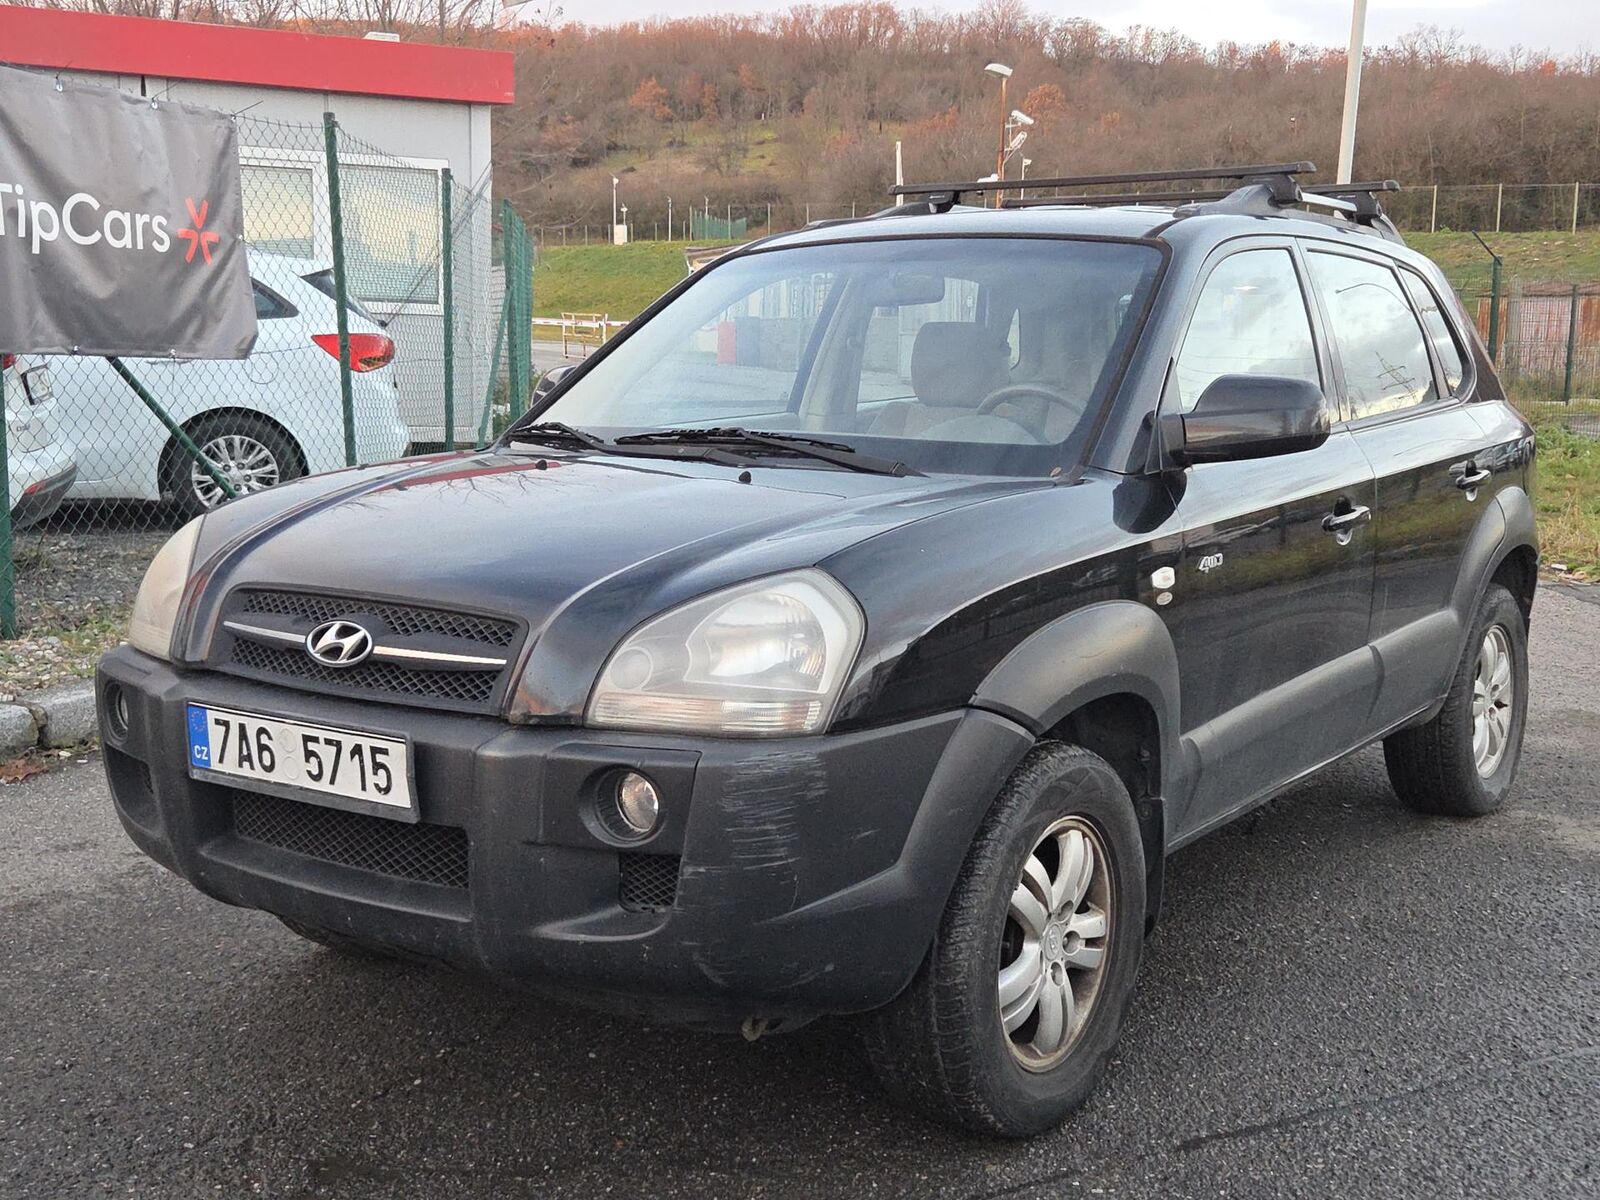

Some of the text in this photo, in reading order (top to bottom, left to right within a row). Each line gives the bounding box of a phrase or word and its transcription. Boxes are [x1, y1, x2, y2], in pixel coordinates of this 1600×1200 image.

[194, 745, 209, 760] CZ
[214, 718, 392, 795] 7A6 5715
